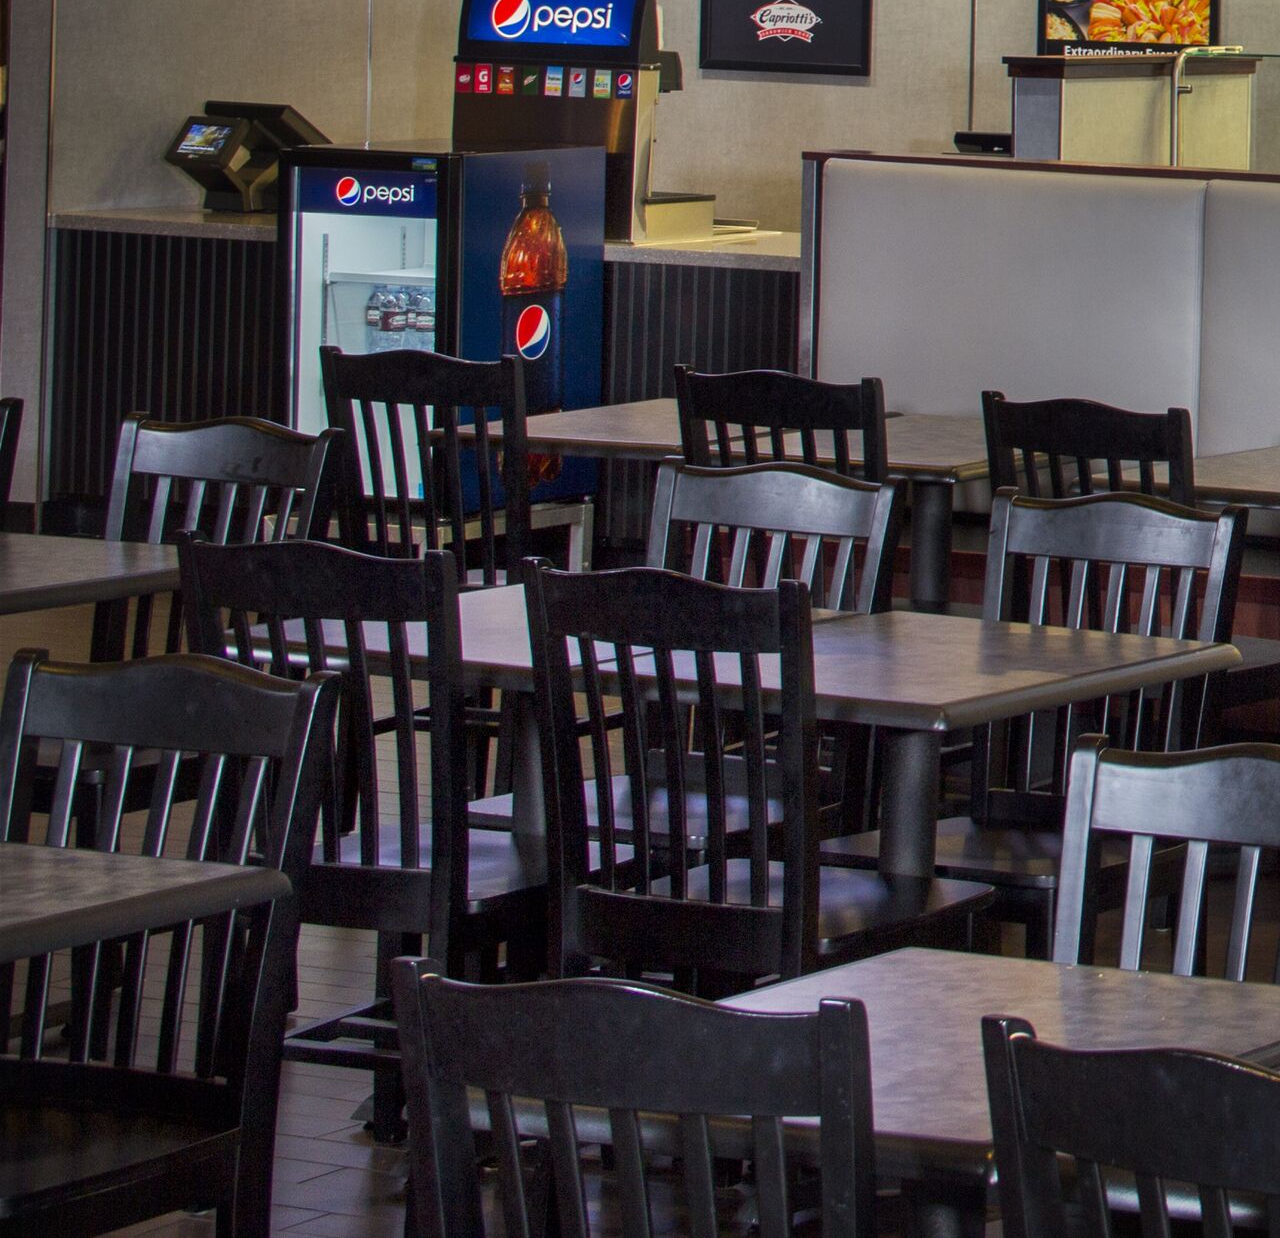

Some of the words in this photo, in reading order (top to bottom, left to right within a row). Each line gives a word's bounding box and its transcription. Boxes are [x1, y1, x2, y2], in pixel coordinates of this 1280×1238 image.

[532, 2, 613, 34] pepsi
[758, 8, 815, 27] Capriotti's
[363, 183, 416, 205] pepsi
